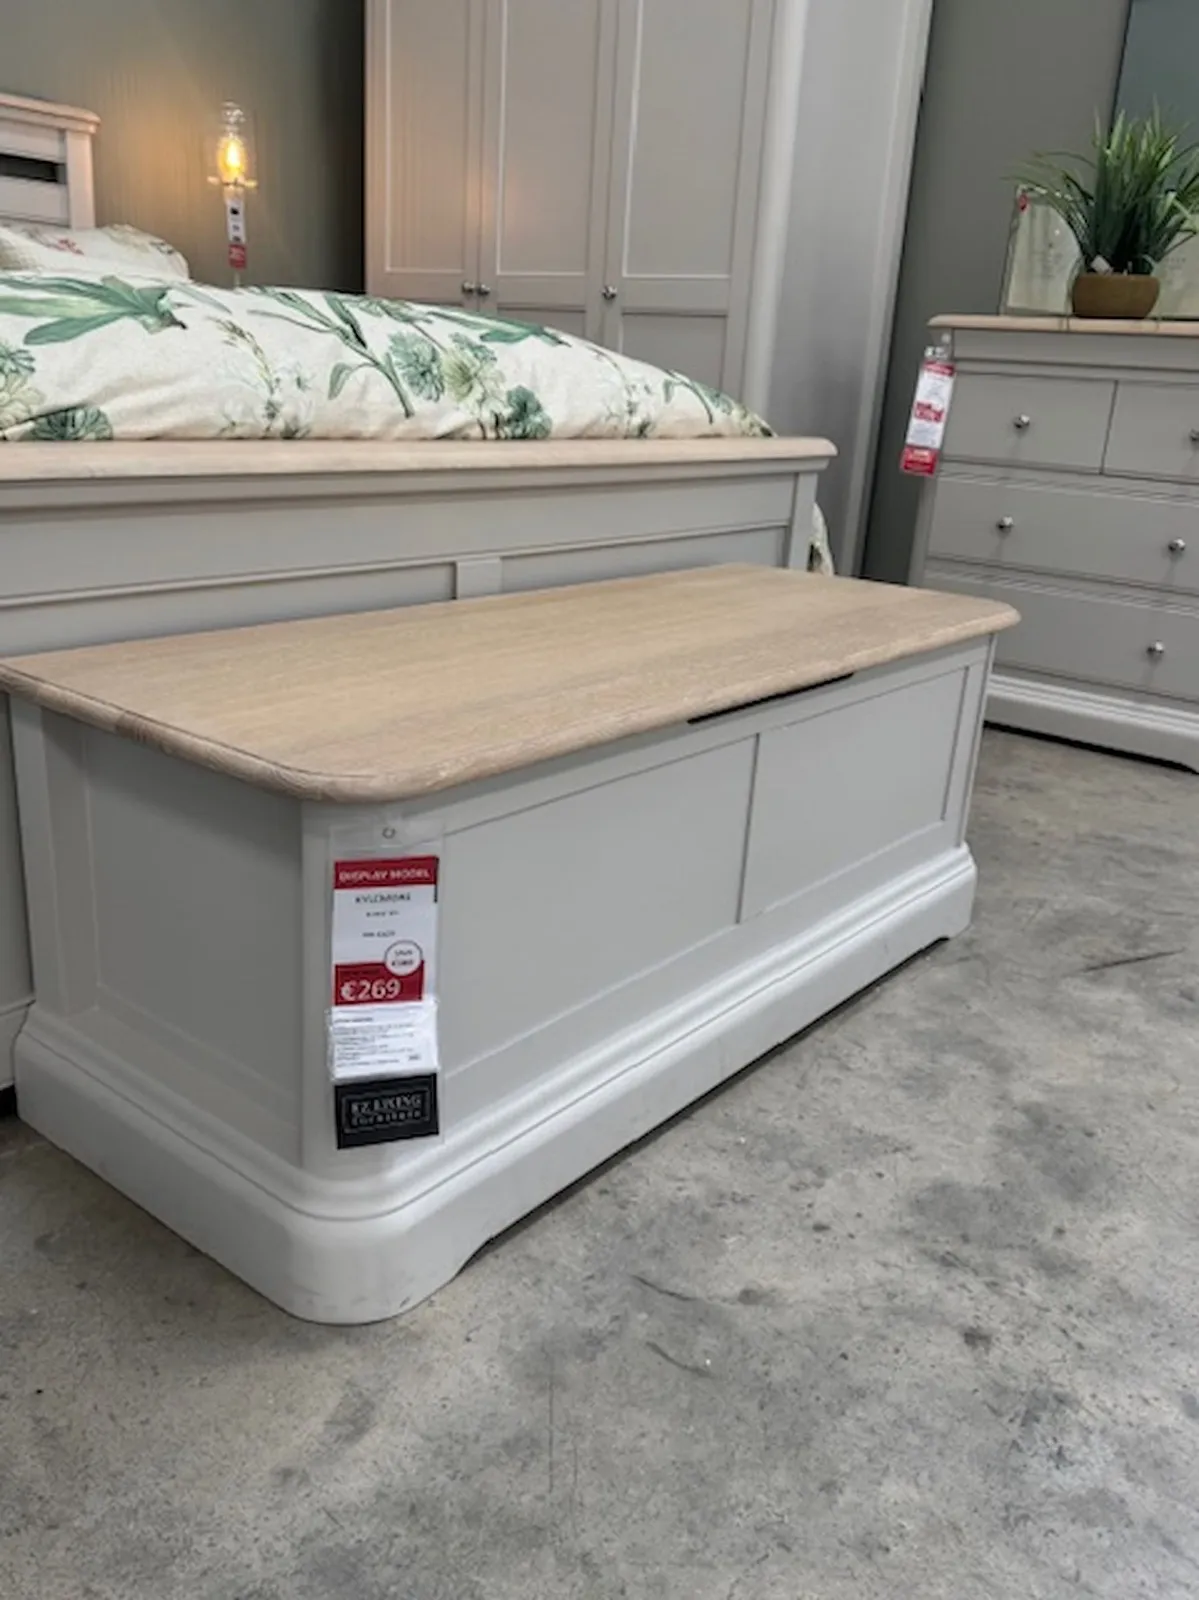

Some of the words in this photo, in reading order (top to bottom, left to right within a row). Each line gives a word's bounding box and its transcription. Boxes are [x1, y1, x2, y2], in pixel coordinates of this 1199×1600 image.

[339, 870, 387, 882] DISPLAY
[390, 868, 429, 879] MODEL
[341, 978, 401, 1001] €269
